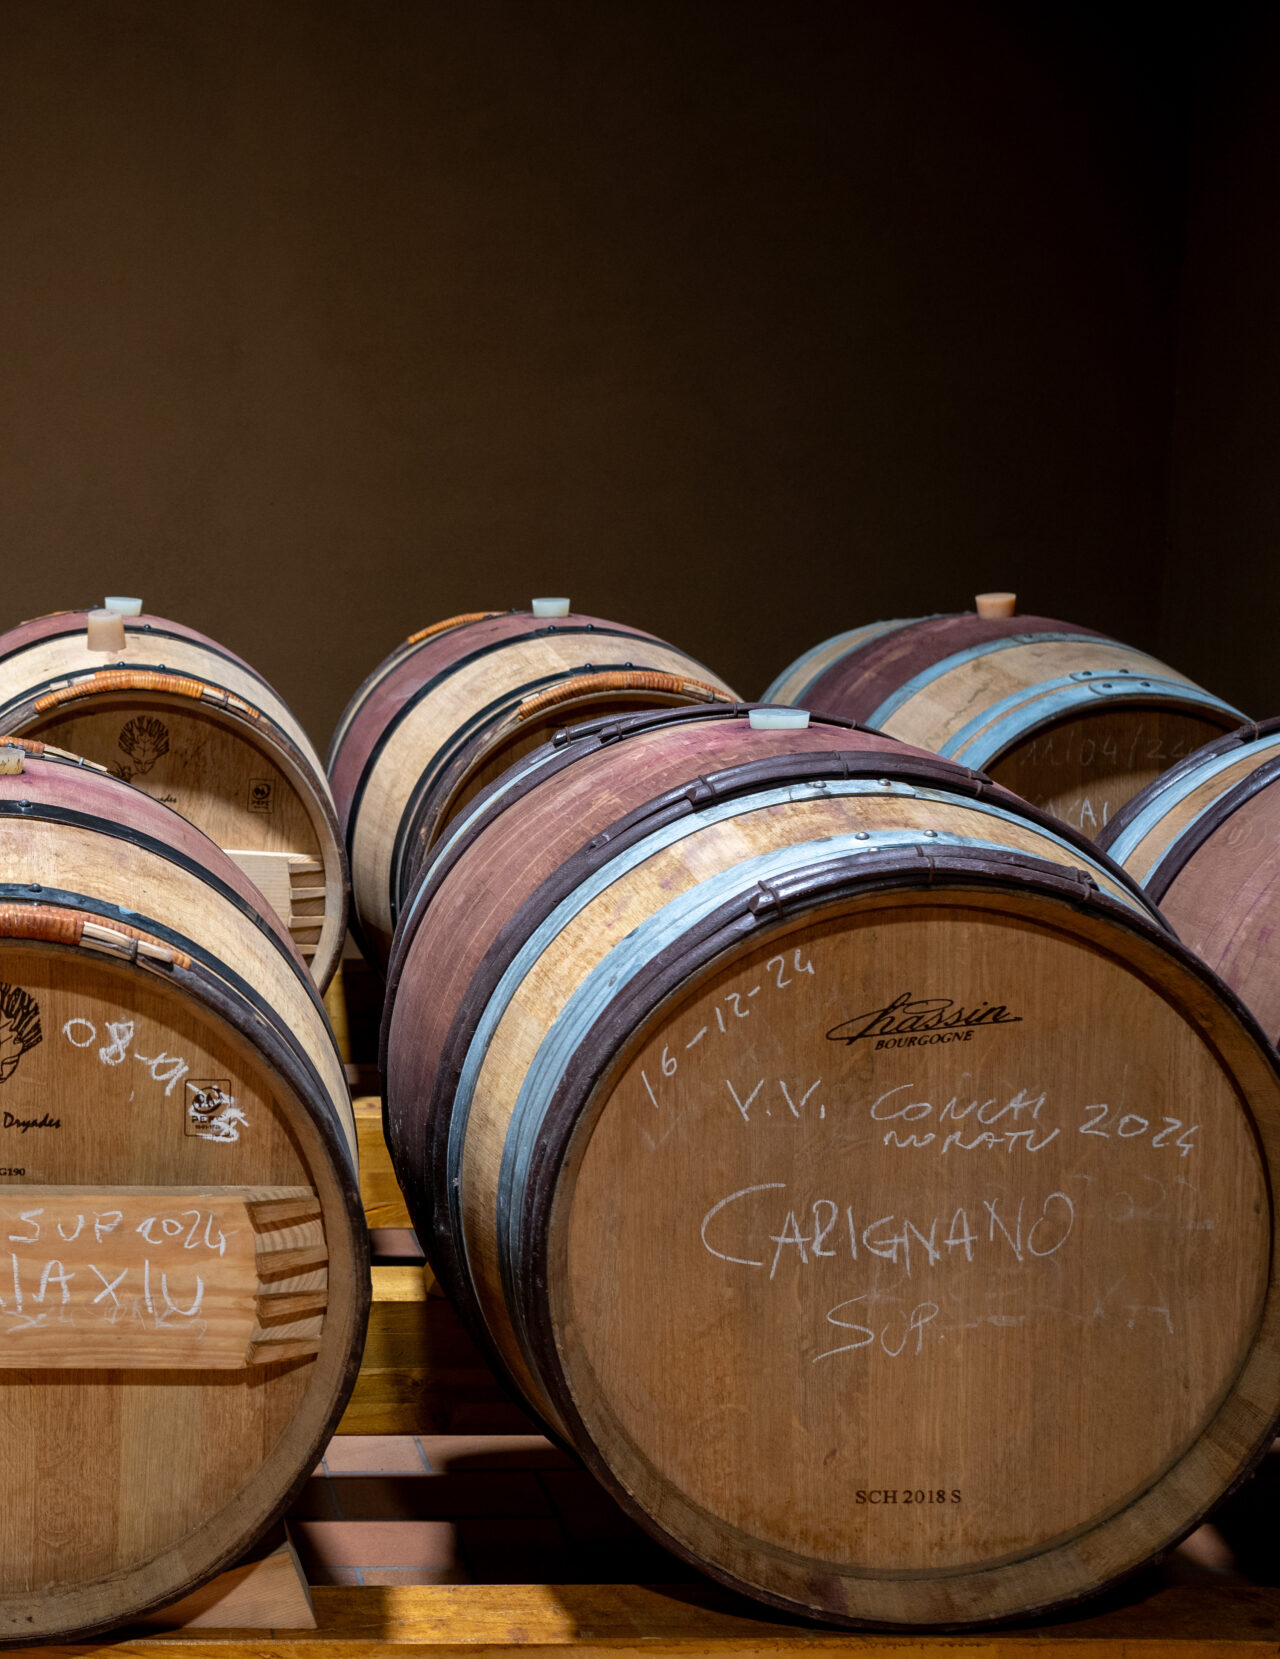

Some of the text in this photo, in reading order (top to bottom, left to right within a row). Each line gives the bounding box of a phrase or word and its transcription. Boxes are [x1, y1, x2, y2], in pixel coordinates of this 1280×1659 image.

[641, 948, 816, 1109] 16-12-24
[825, 991, 1024, 1047] Chassin
[874, 1029, 976, 1051] BOURGOGNE
[3, 1111, 62, 1134] Dryades
[1078, 1103, 1201, 1158] 2024
[8, 1208, 123, 1244] SUP
[136, 1209, 239, 1257] 2024
[701, 1183, 1074, 1280] CARIGNANO
[855, 1490, 963, 1505] SCH 2018 S
